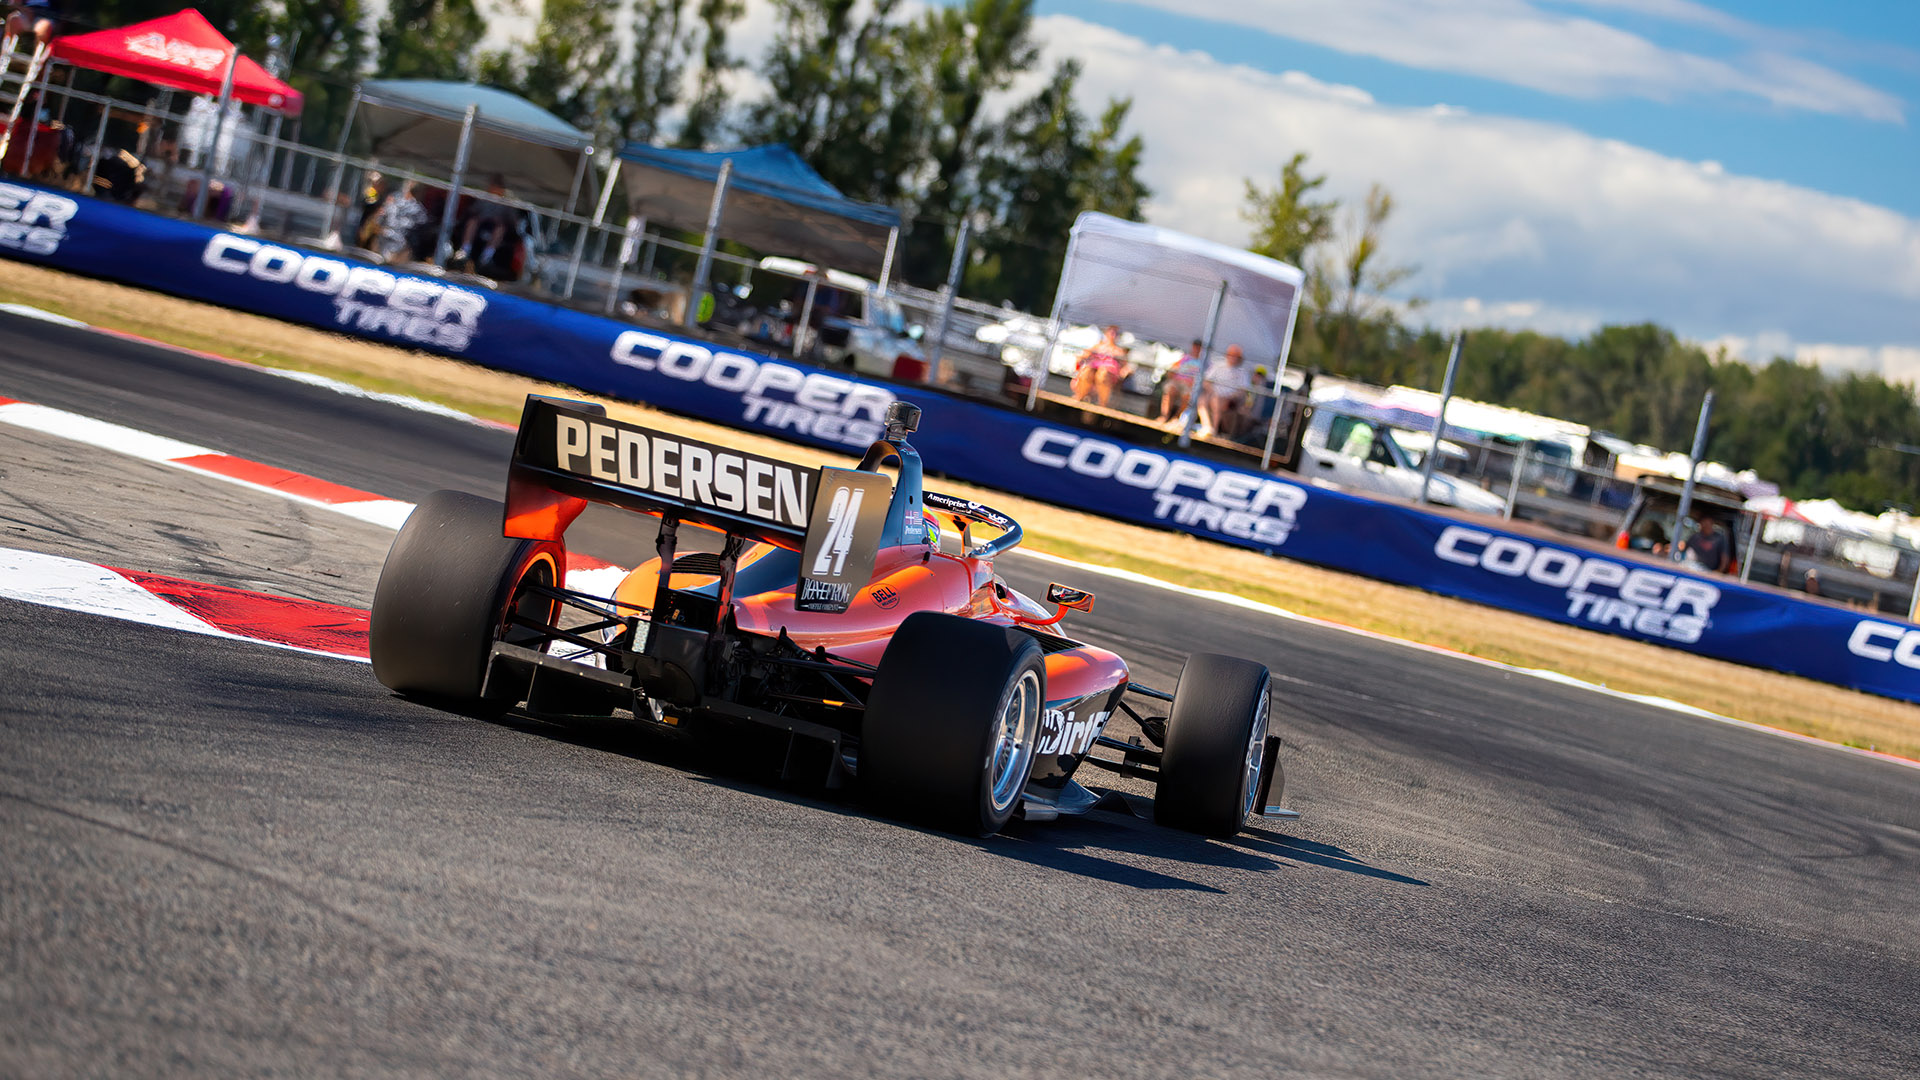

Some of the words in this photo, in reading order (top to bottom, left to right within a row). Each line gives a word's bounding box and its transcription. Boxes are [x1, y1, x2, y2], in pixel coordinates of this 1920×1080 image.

[202, 233, 488, 328] COOPER
[334, 297, 475, 351] TIRES
[610, 330, 897, 423] COOPER
[742, 394, 886, 448] TIRES
[556, 414, 808, 527] PEDERSEN
[1021, 426, 1308, 522] COOPER
[927, 493, 967, 508] Ameriprise
[1153, 493, 1295, 545] TIRES
[812, 486, 865, 577] 24
[801, 578, 852, 603] BONEFROG
[871, 586, 897, 603] BELL
[1434, 525, 1721, 619] COOPER
[1566, 588, 1708, 643] TIRES
